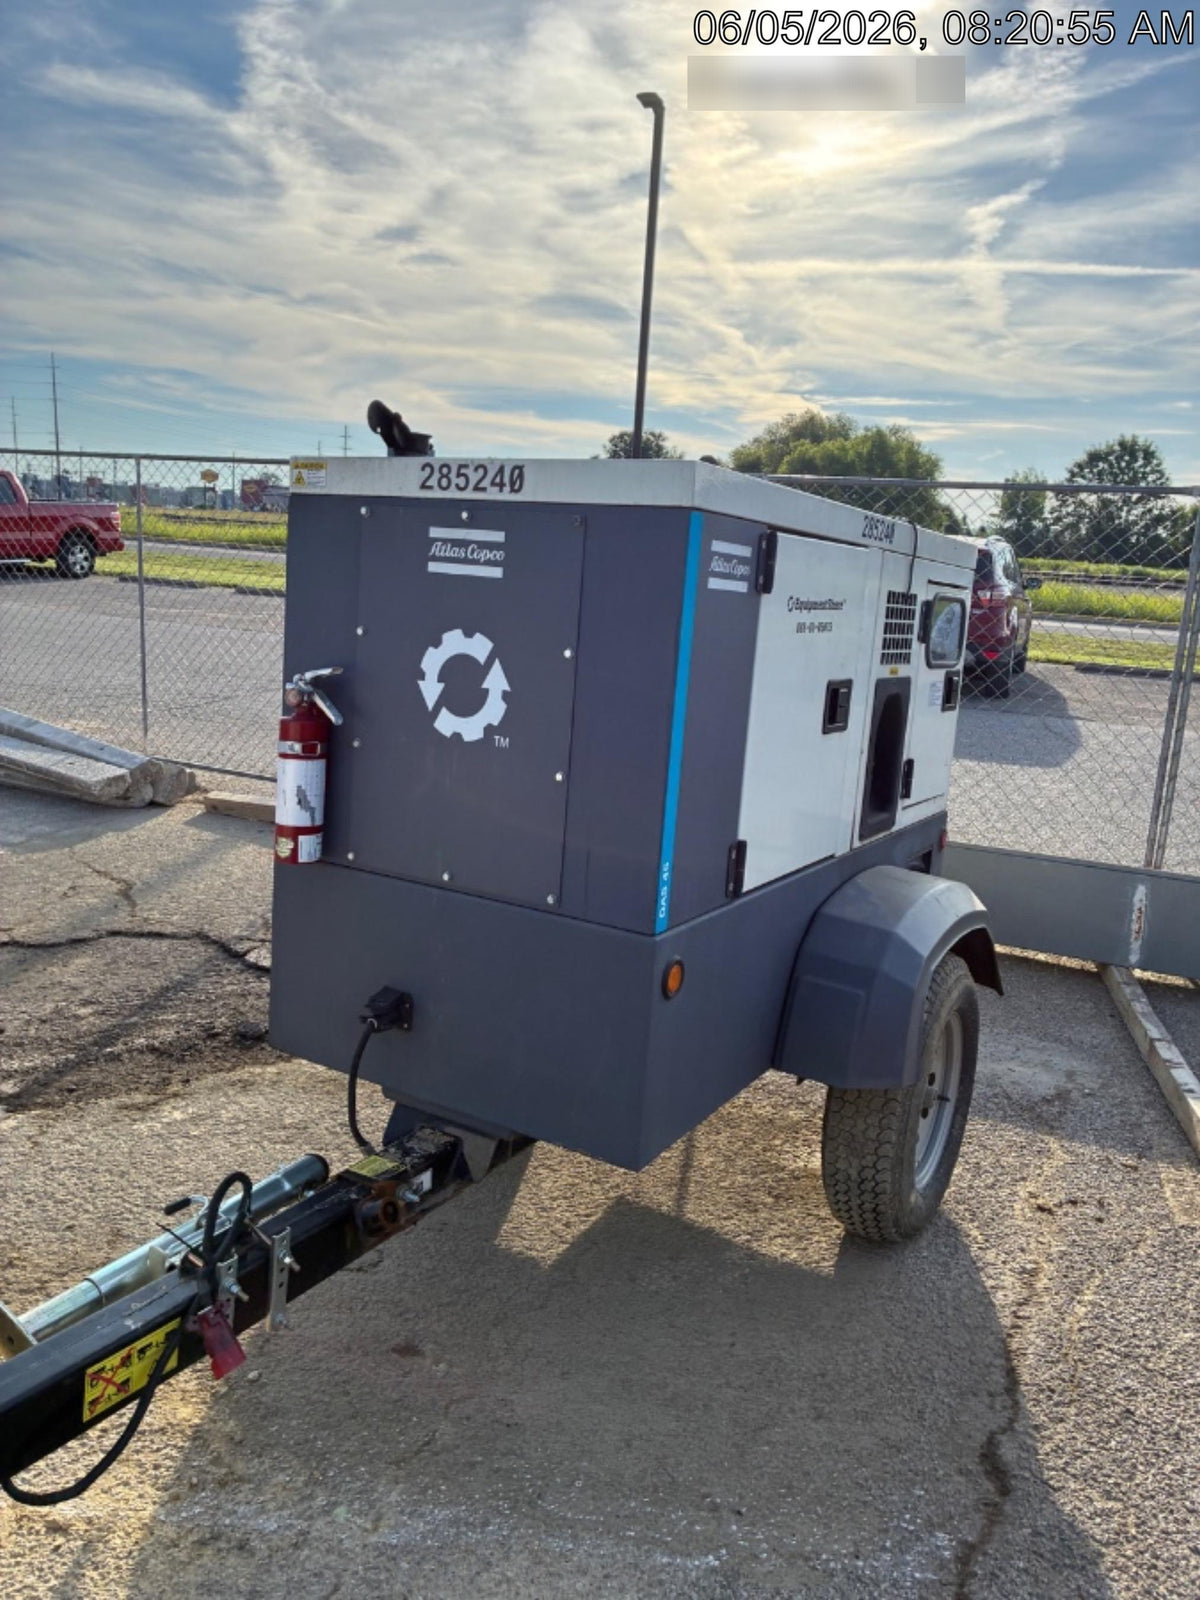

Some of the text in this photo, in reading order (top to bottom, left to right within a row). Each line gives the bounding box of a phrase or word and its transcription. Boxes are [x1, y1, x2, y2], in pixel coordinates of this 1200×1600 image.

[419, 462, 525, 494] 285240
[428, 541, 506, 563] Atlas Copco
[493, 735, 510, 748] TM
